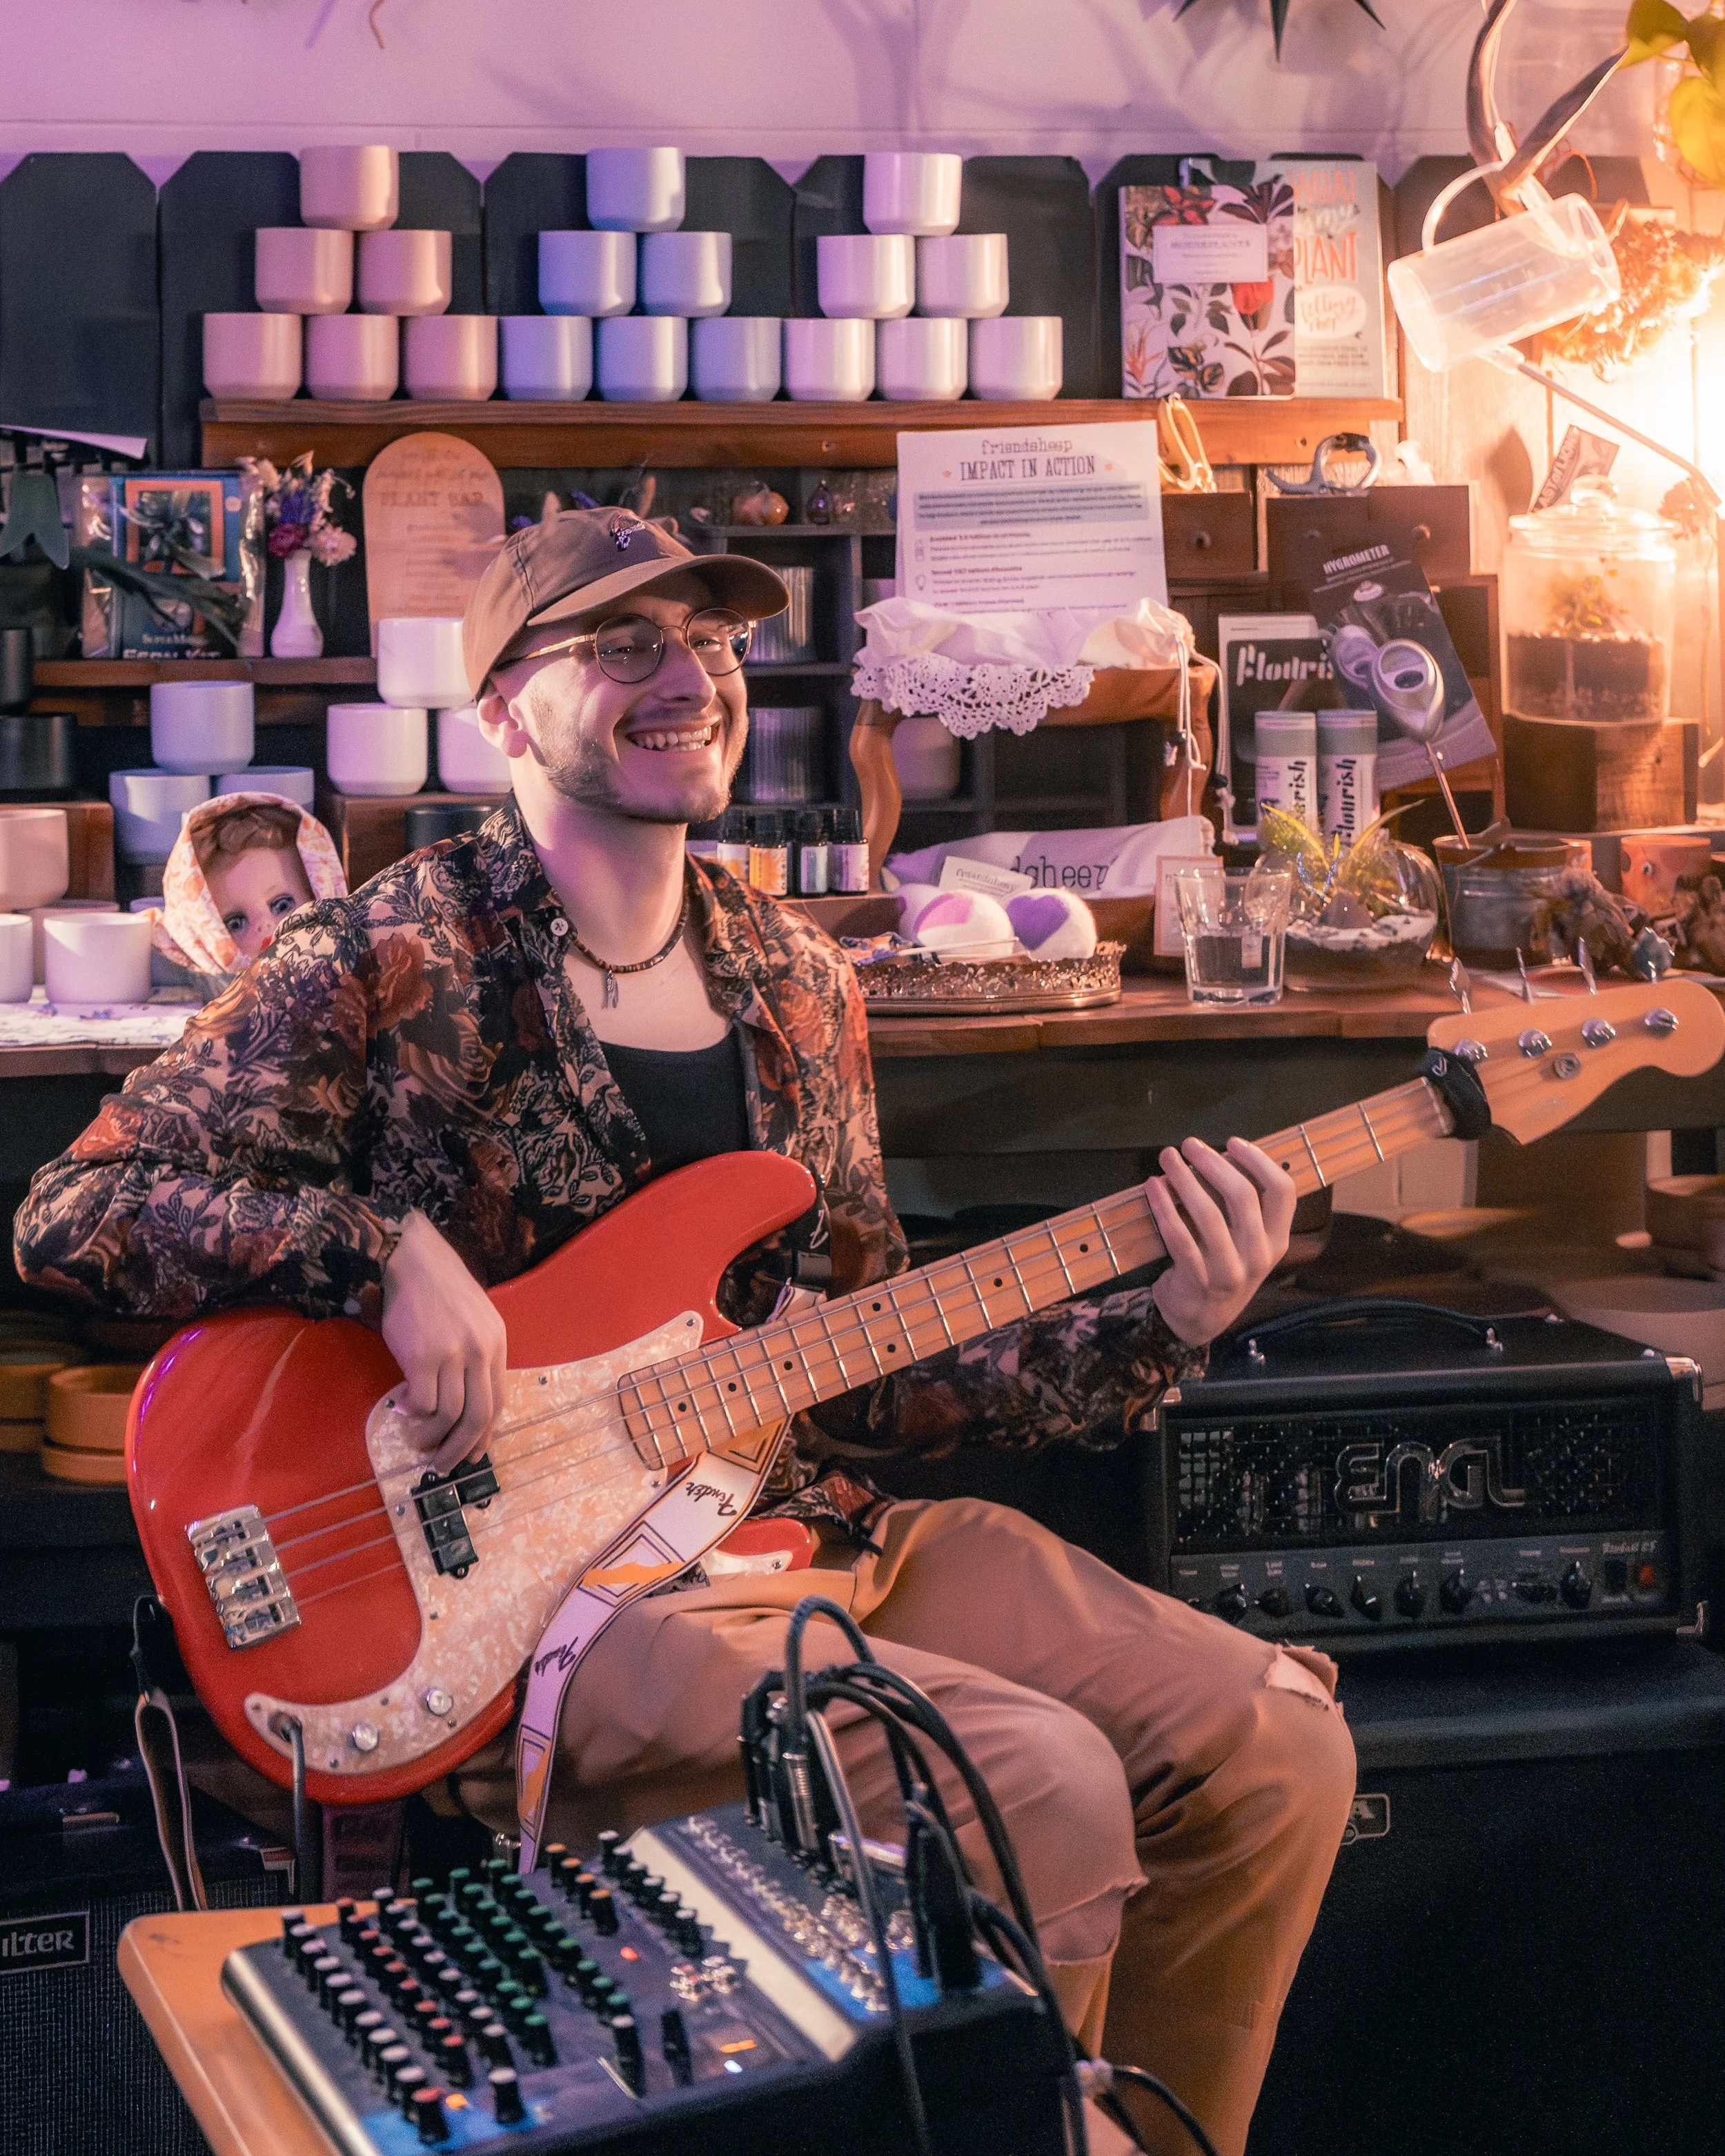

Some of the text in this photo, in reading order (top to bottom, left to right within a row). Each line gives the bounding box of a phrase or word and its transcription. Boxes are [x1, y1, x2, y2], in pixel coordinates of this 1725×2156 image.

[959, 455, 1096, 482] IMPACT IN ACTION
[1322, 544, 1392, 575] HYGROMETER
[684, 1481, 738, 1516] Fender
